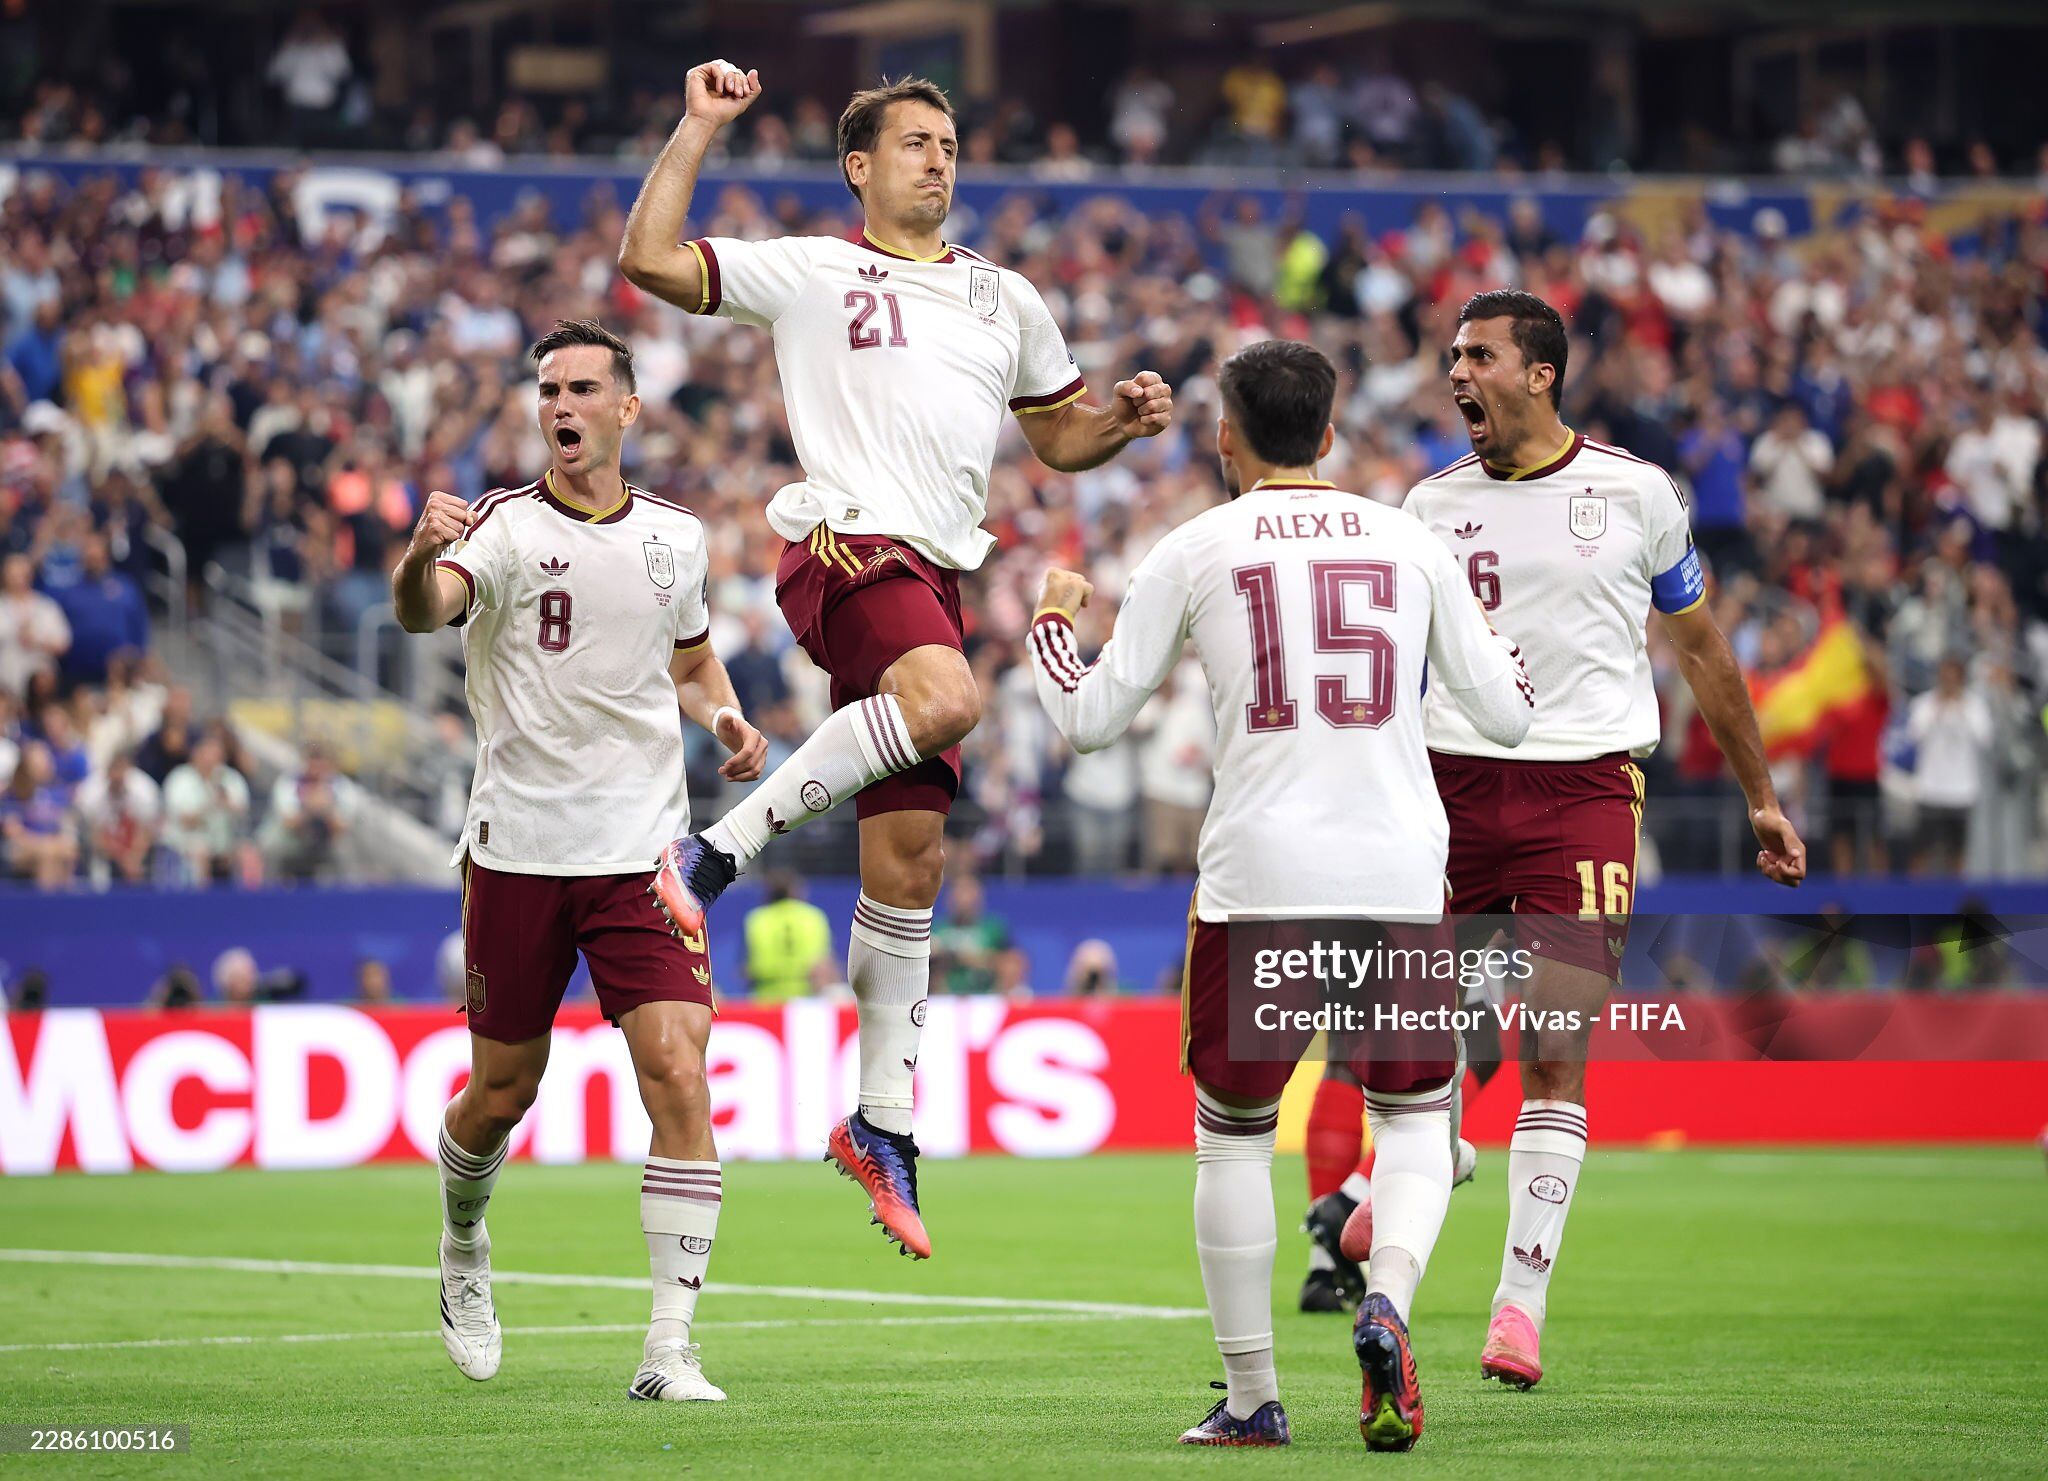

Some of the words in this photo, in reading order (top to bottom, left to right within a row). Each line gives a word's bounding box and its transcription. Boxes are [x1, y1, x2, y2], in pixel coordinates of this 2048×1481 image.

[844, 290, 908, 351] 21
[1255, 513, 1333, 540] ALEX
[1341, 512, 1370, 536] B.
[538, 591, 572, 652] 8
[1232, 560, 1398, 734] 15
[1576, 860, 1629, 926] 16
